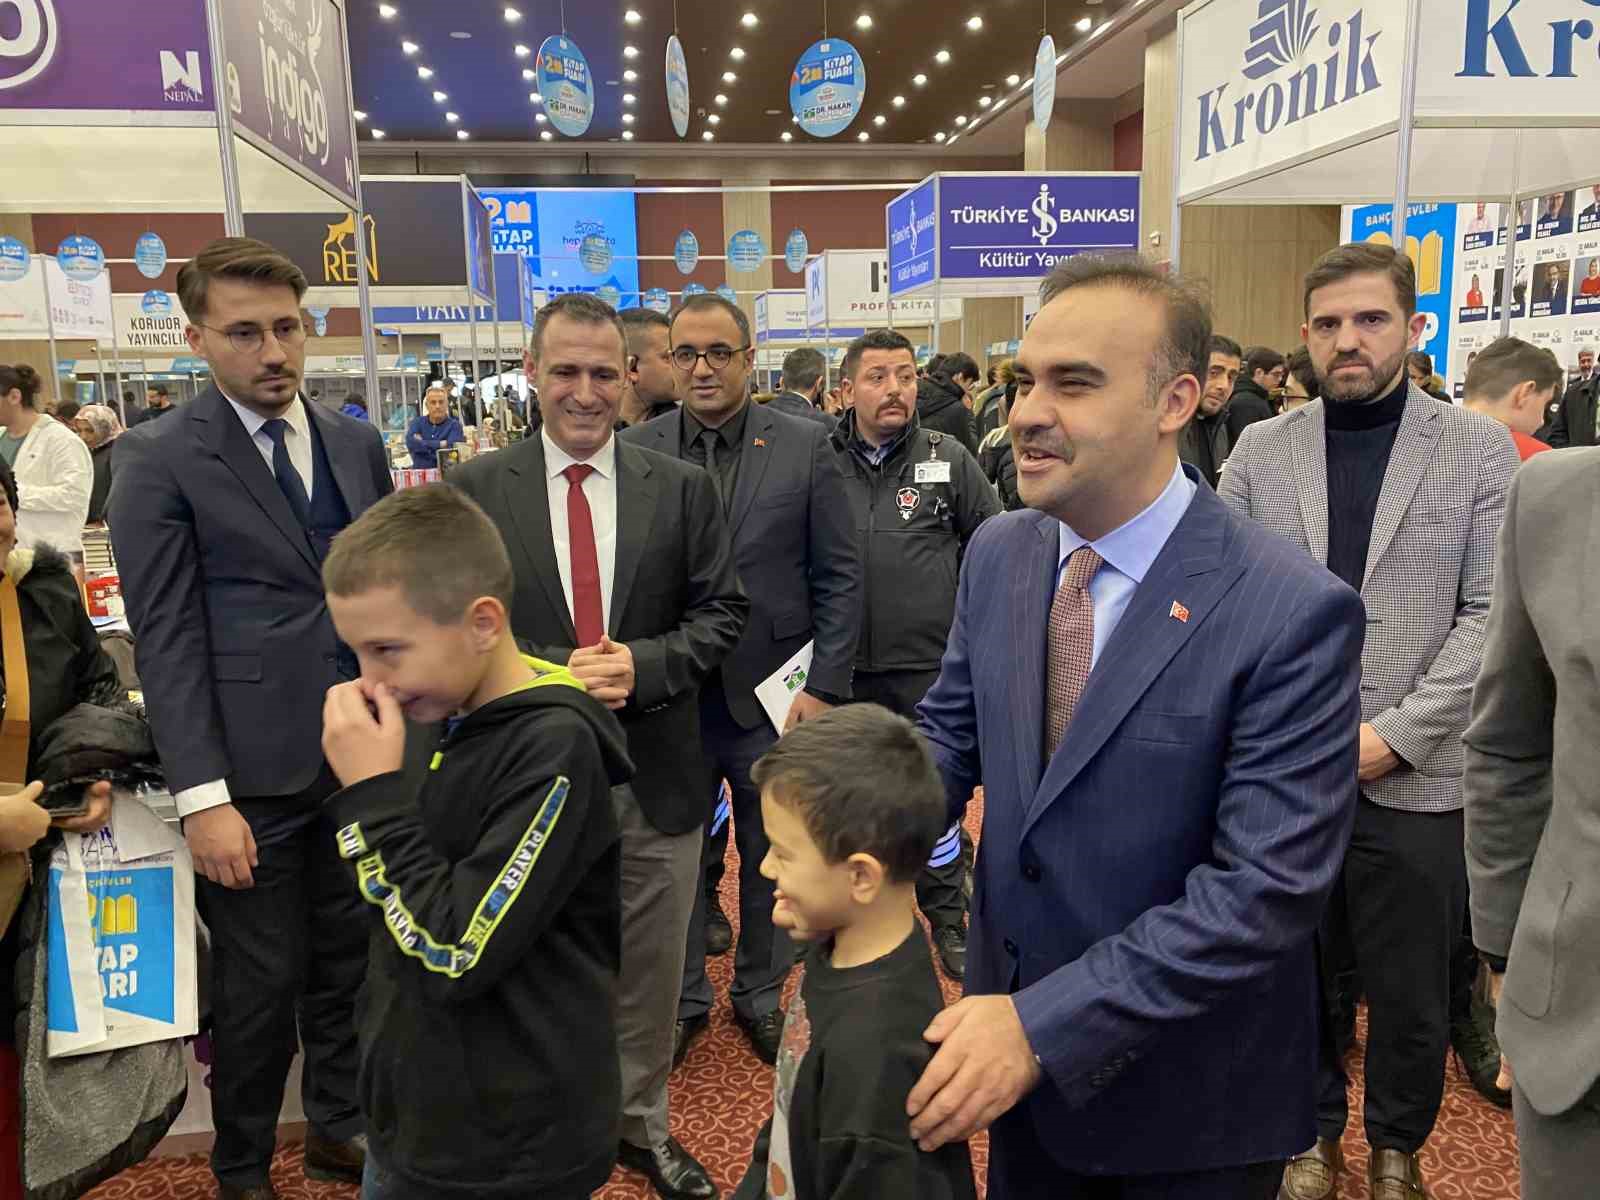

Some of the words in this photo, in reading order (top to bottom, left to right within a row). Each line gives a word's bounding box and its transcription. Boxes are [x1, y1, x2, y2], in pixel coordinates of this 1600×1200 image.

[1454, 0, 1600, 78] Kr
[1194, 8, 1382, 161] Kronik
[164, 90, 203, 103] NEPAL
[950, 206, 1028, 225] TÜRKİYE
[1059, 208, 1135, 224] BANKASI
[1365, 202, 1439, 227] BAHÇEVLER
[493, 229, 533, 244] İTAP
[980, 252, 1033, 268] Kültür
[500, 829, 545, 890] PLAYER
